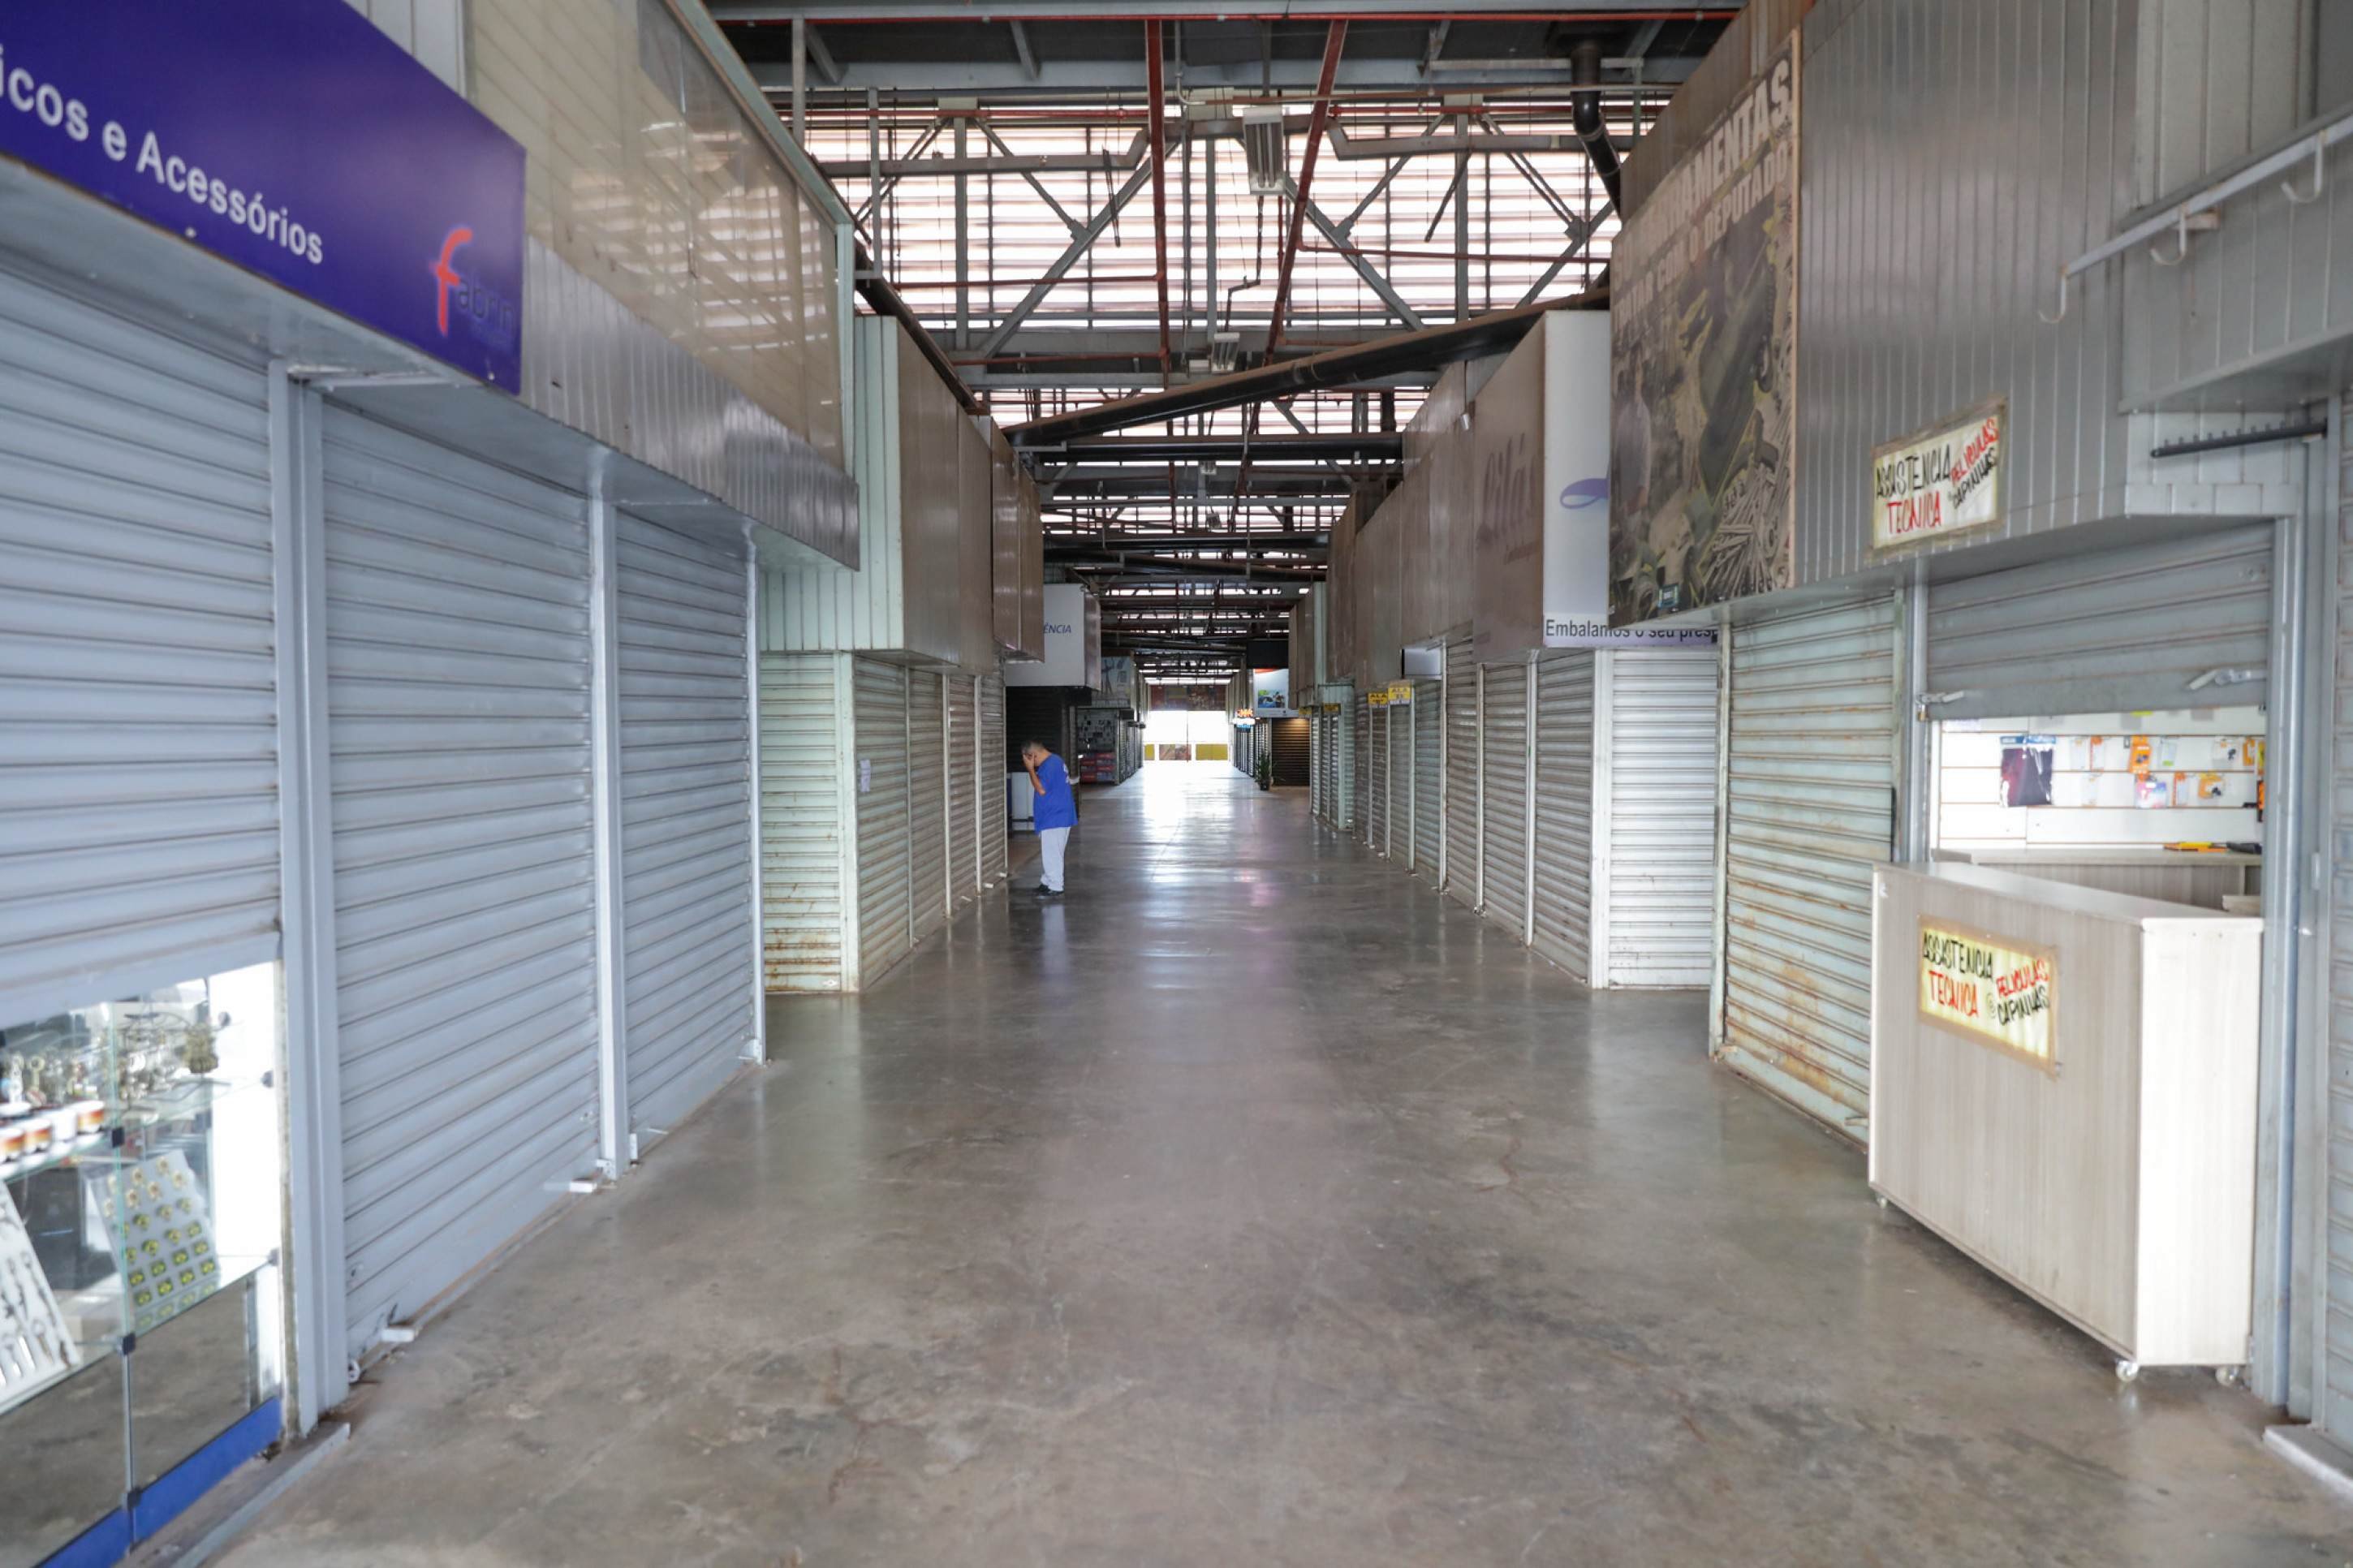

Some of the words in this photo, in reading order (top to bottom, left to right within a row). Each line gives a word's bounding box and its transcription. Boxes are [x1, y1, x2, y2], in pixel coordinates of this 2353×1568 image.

[102, 121, 127, 162] e
[136, 130, 323, 264] Acessórios
[1704, 138, 1788, 251] DEPUTADO
[1545, 619, 1631, 638] Embalamos
